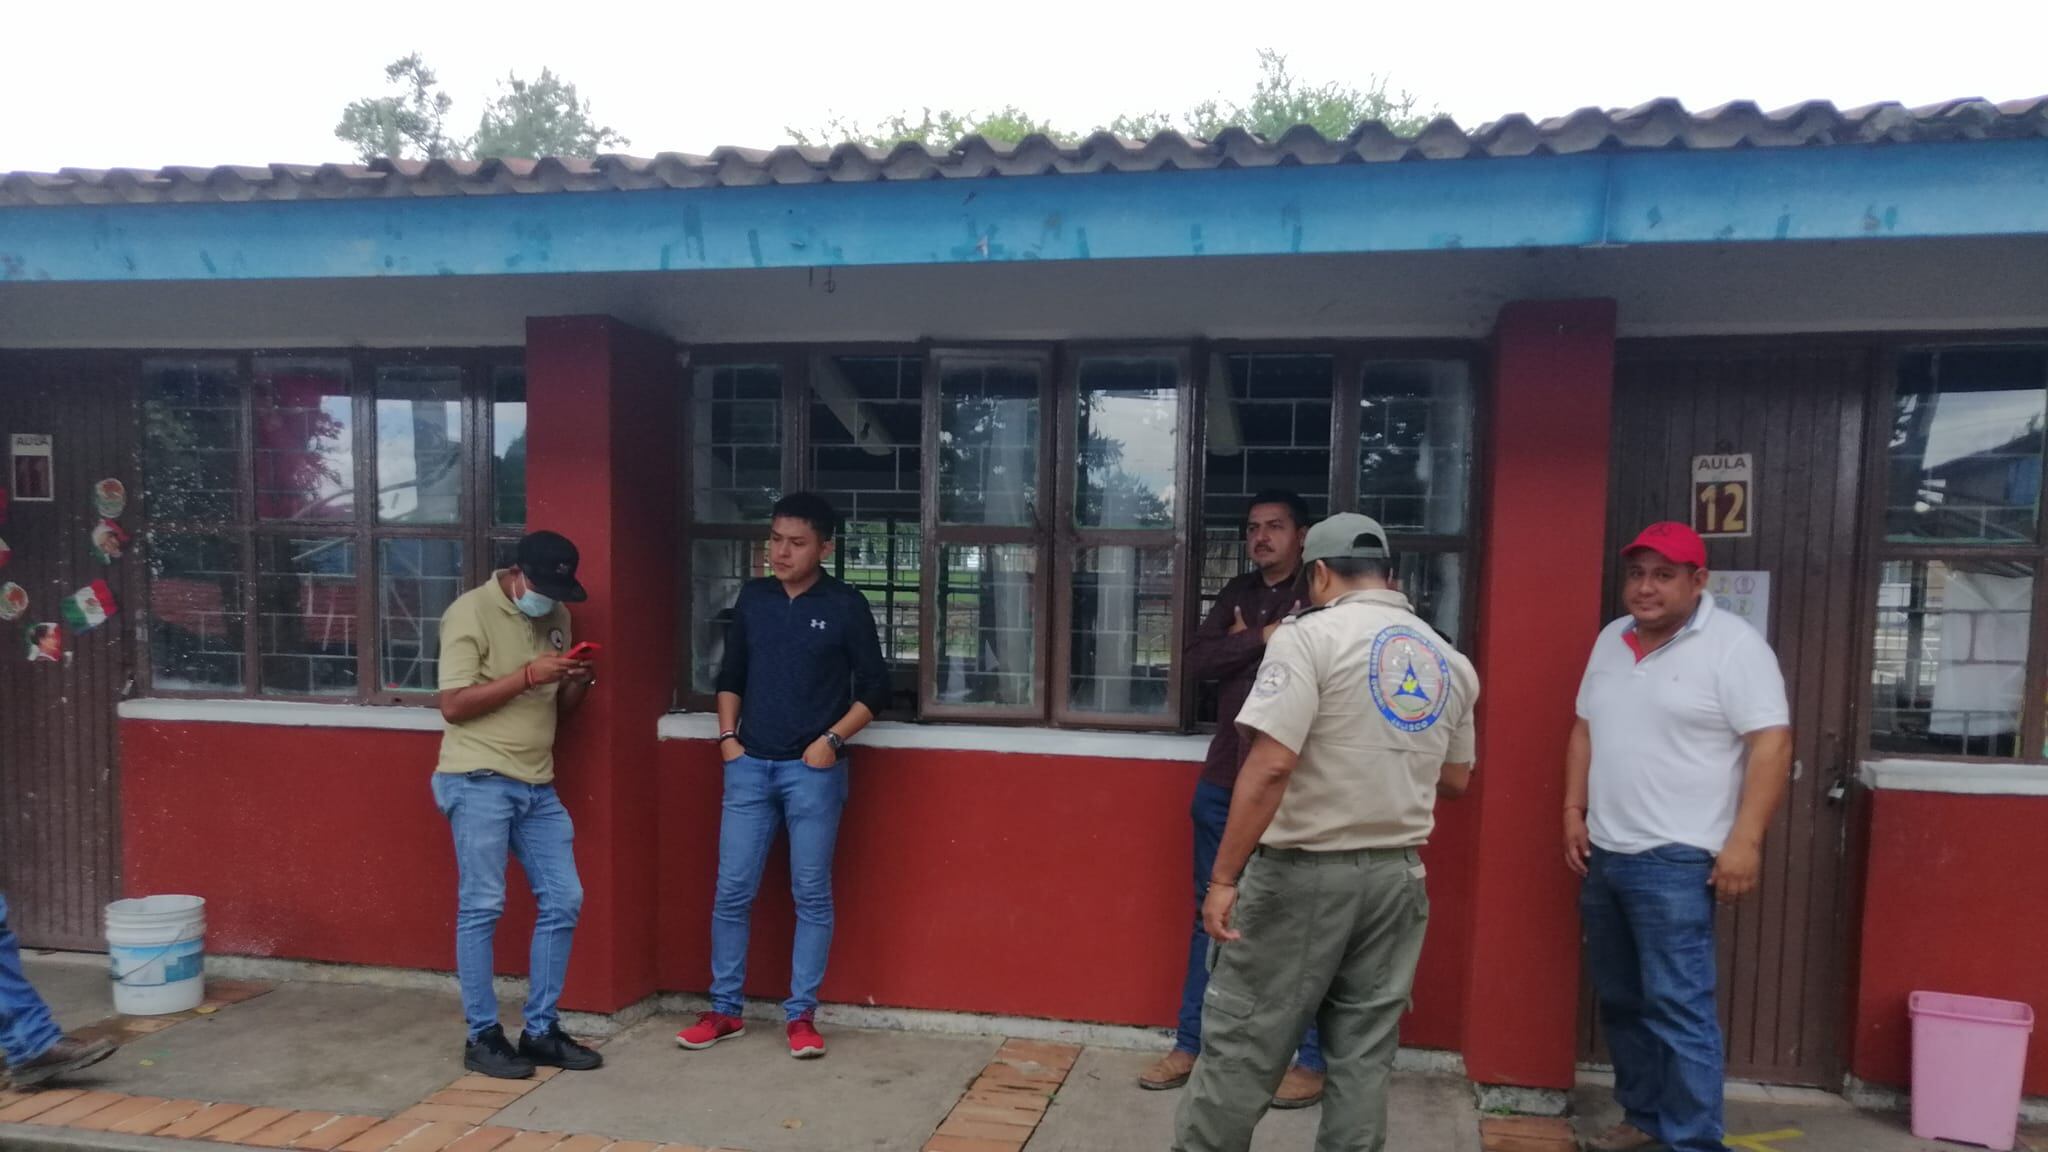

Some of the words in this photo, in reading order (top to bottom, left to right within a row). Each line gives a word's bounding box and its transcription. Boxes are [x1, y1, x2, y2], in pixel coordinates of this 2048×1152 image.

[1698, 457, 1746, 471] AULA
[1700, 483, 1744, 531] 12
[1389, 718, 1429, 732] JALISCO
